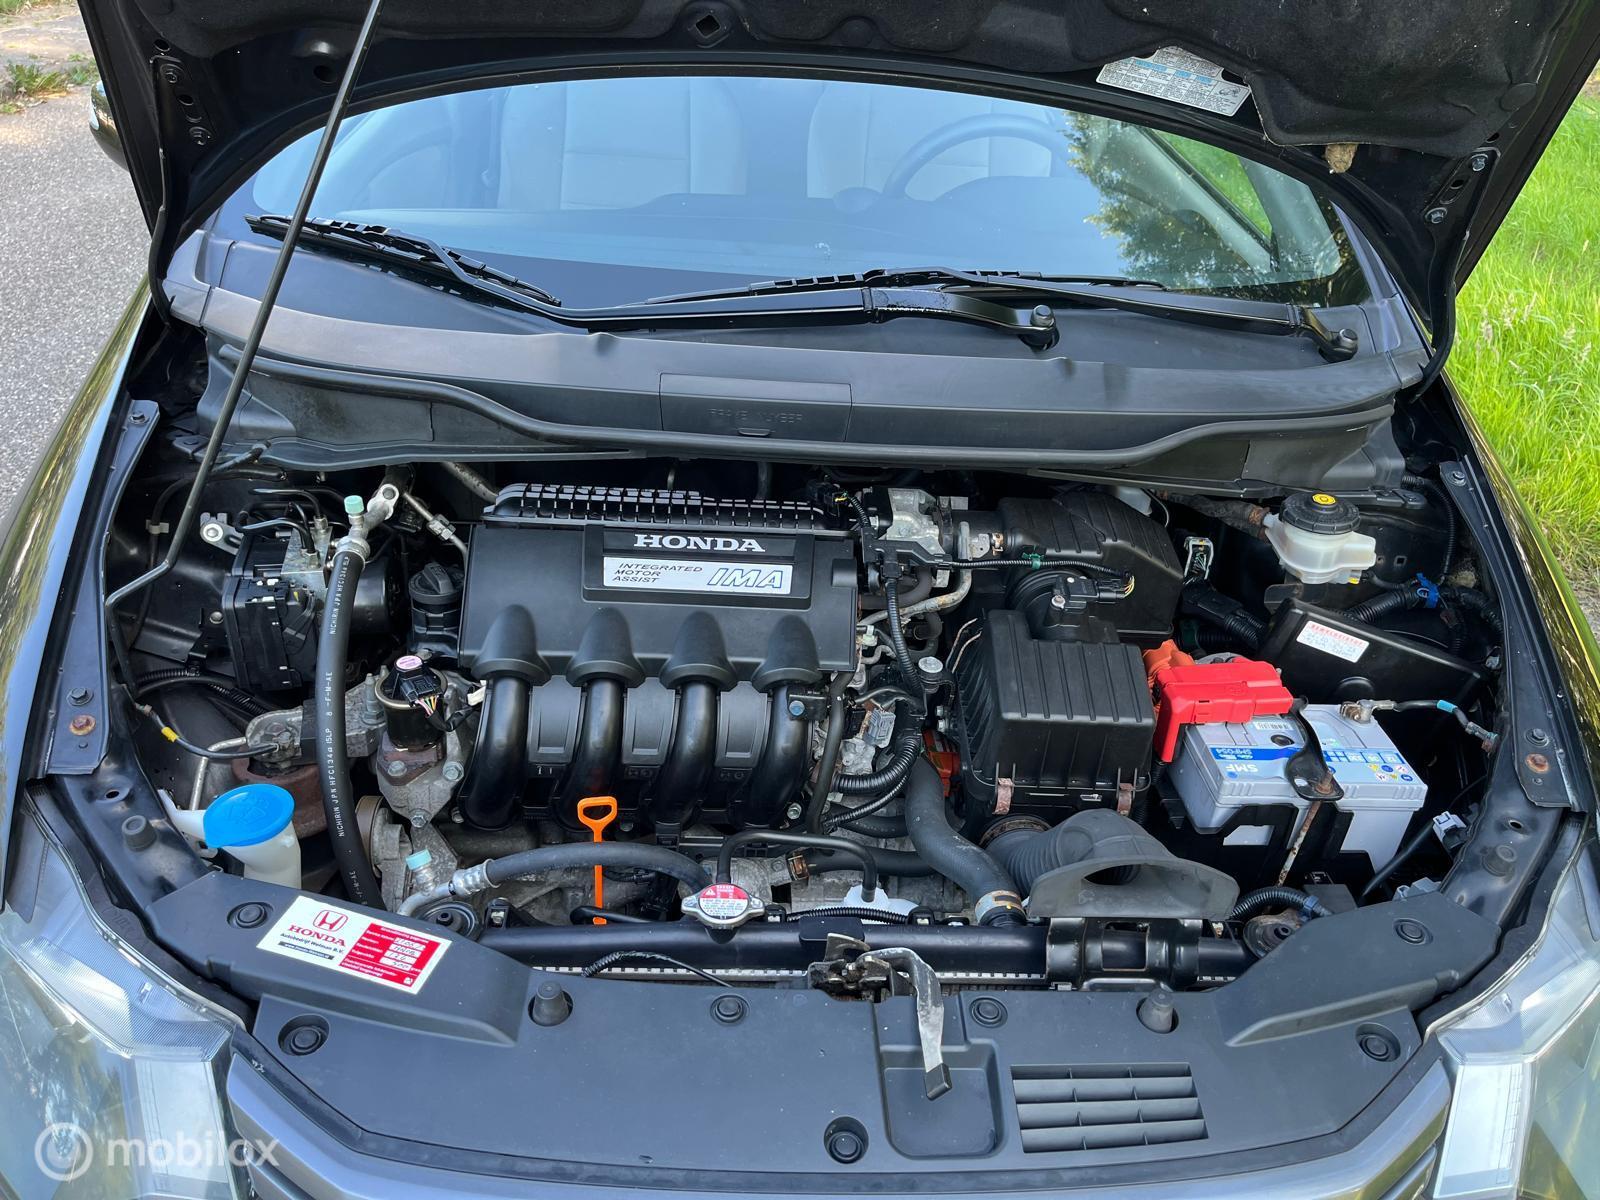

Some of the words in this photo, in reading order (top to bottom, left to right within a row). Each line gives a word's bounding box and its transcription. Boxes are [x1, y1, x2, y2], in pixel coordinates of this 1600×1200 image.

[633, 533, 766, 553] HONDA
[619, 563, 703, 572] INTEGRATED
[707, 567, 784, 589] IMA
[1225, 763, 1259, 773] SMF
[331, 788, 339, 803] JPN
[333, 806, 345, 837] NICHIRIN
[288, 924, 345, 947] HONDA
